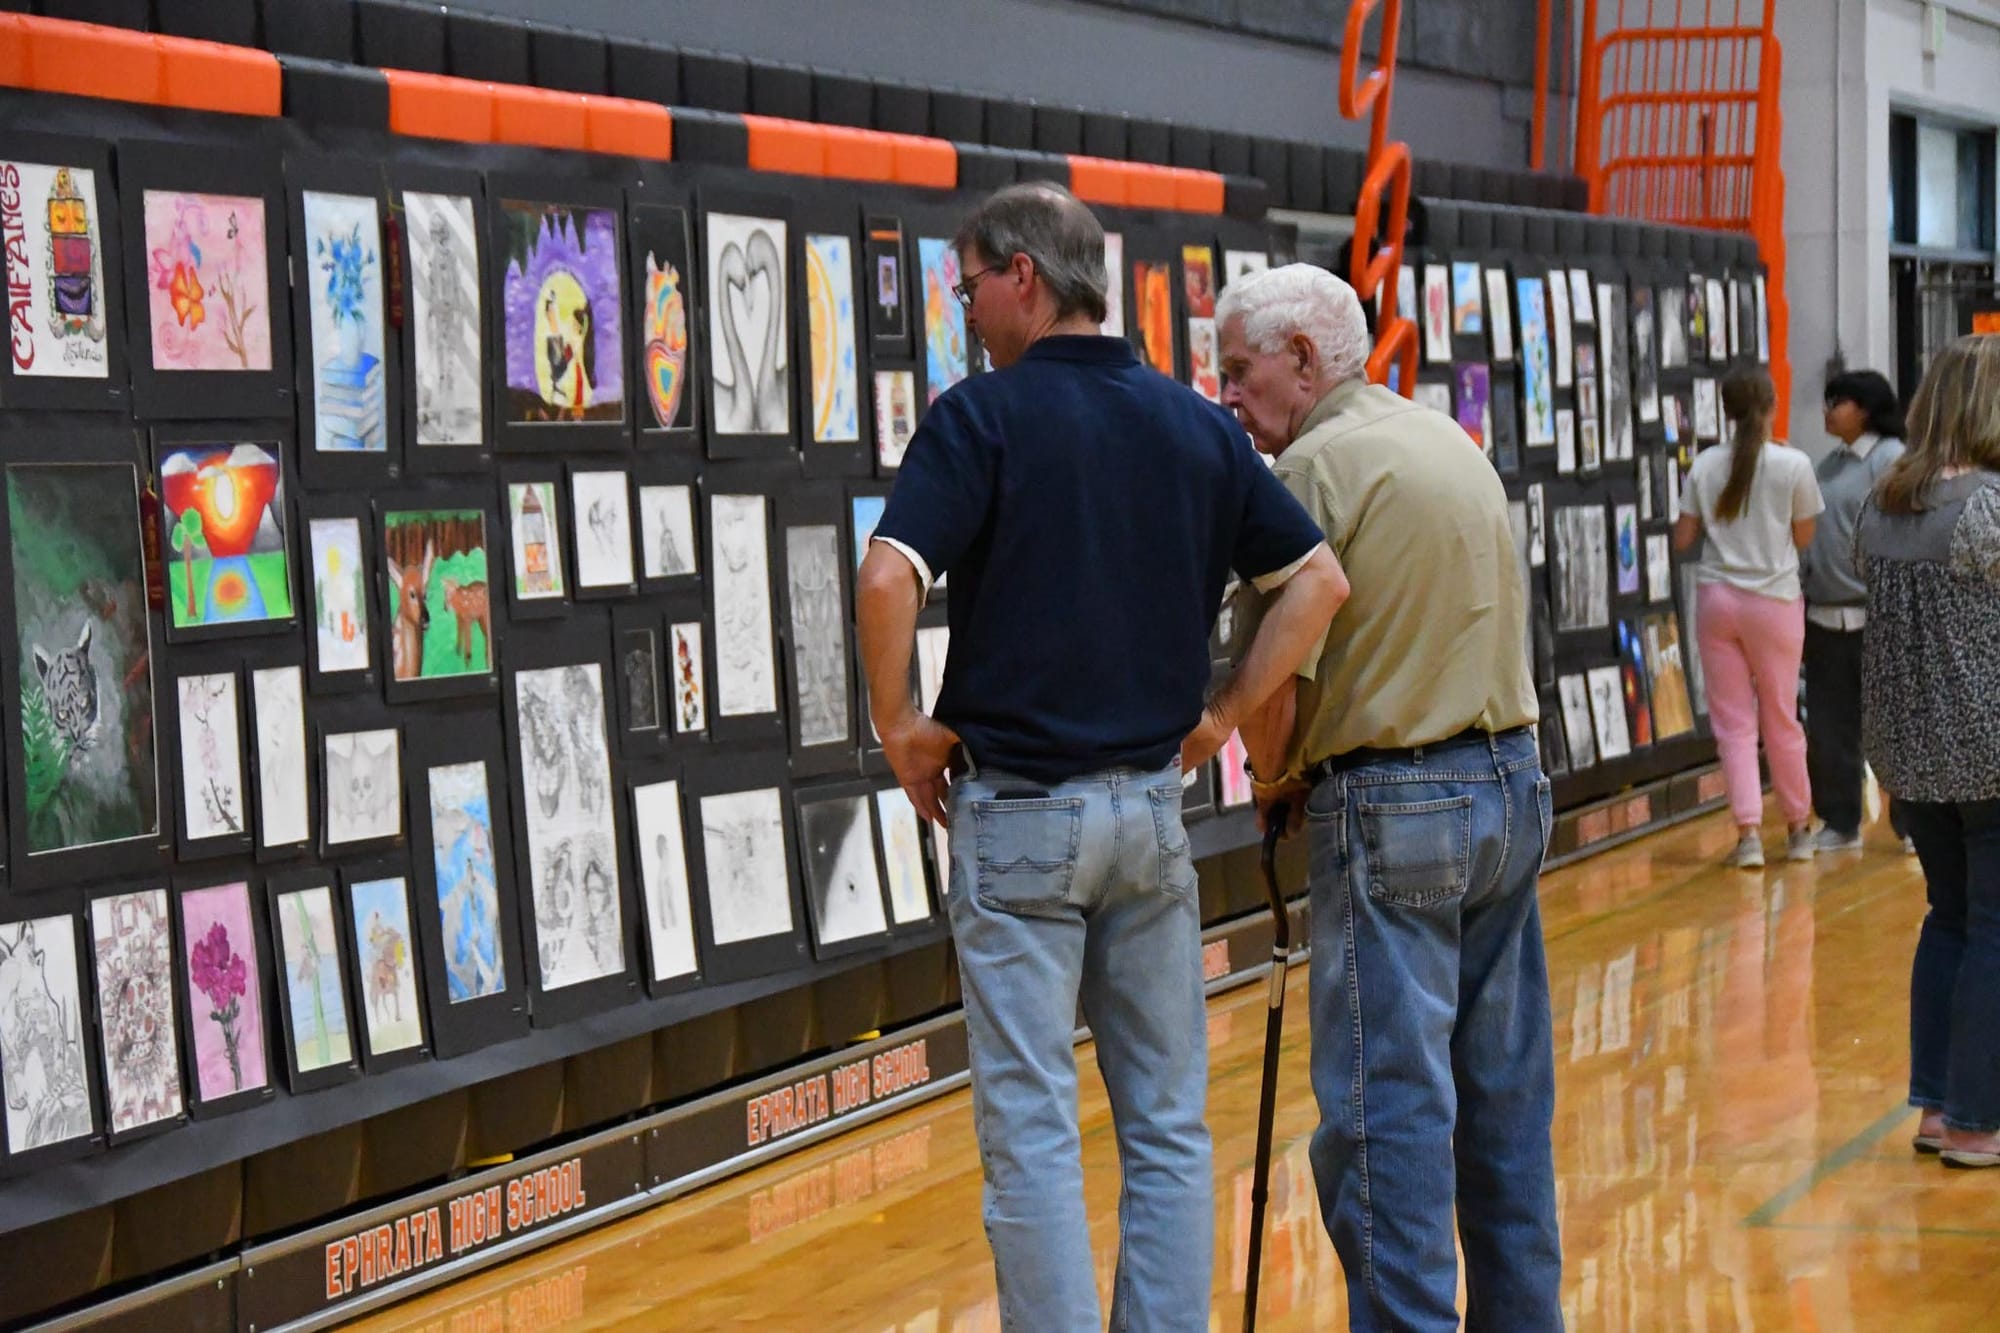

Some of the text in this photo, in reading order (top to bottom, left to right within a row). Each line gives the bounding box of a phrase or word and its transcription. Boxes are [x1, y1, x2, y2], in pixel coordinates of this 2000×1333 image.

[747, 1039, 929, 1146] EPHRATA HIGH SCHOOL
[326, 1158, 585, 1299] EPHRATA HIGH SCHOOL
